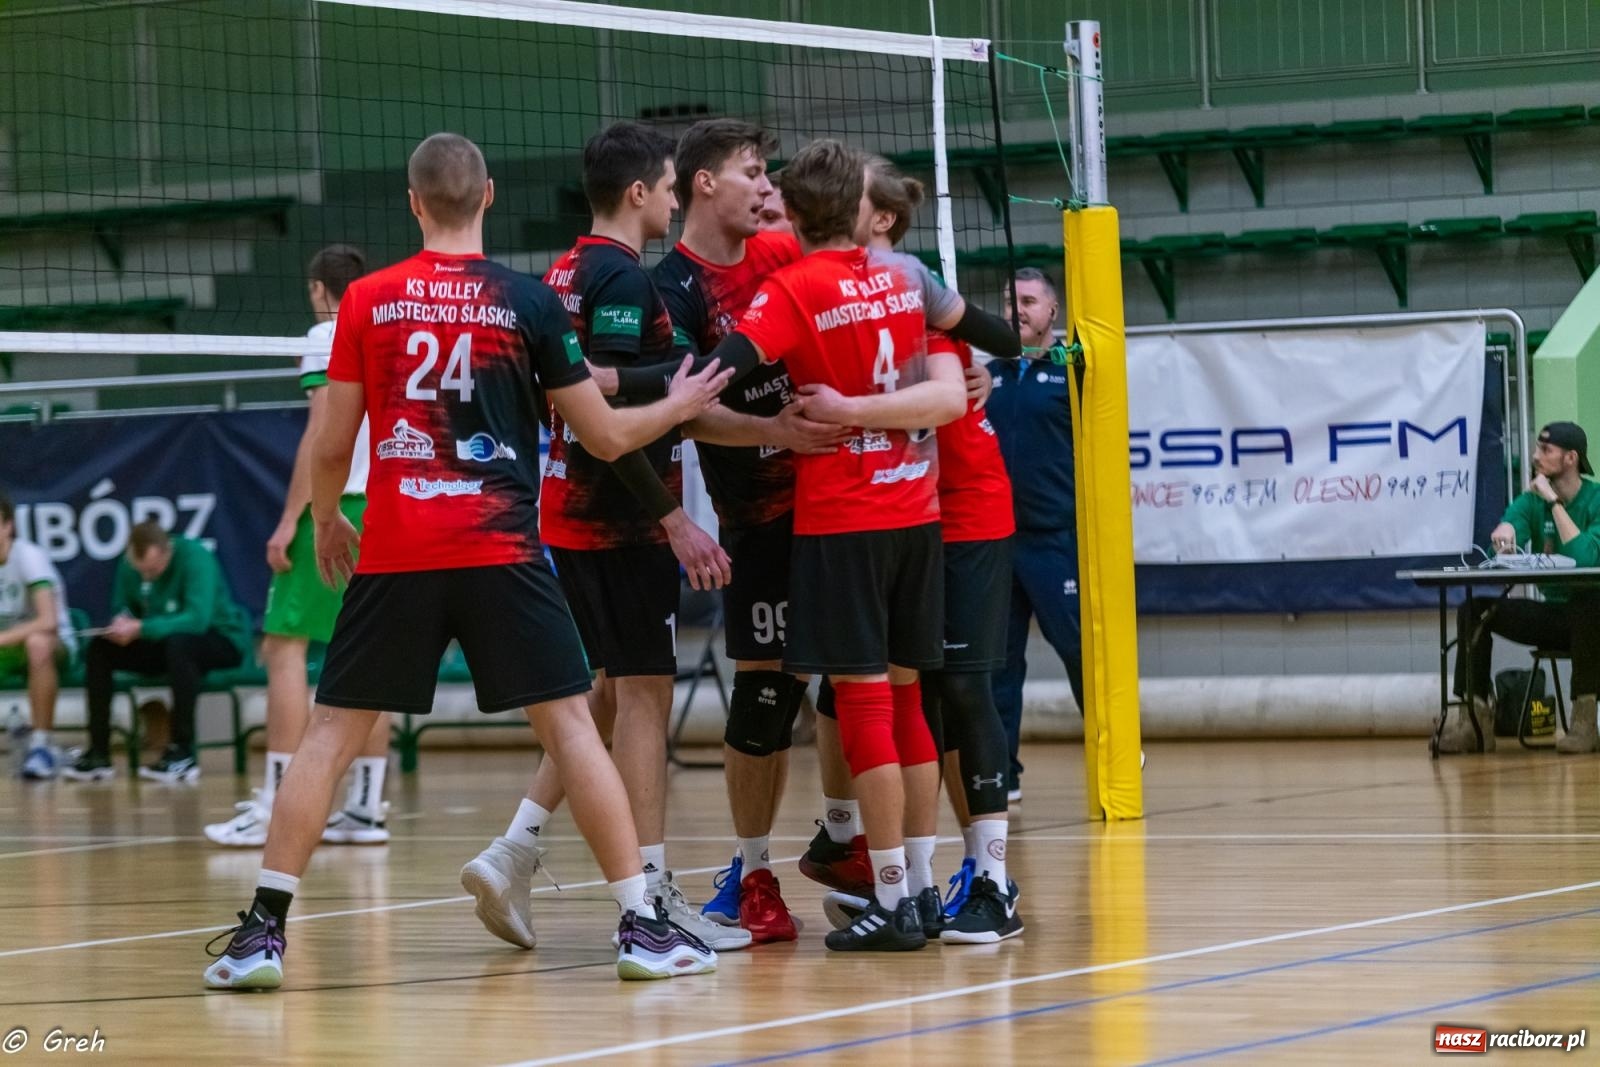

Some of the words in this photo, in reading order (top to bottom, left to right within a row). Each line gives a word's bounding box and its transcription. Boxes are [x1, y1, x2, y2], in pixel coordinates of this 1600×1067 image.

[406, 277, 425, 298] KS
[429, 281, 483, 300] VOLLEY
[838, 279, 857, 297] KS
[372, 300, 457, 326] MIASTECZKO
[460, 302, 517, 330] ŚLĄSKIE
[814, 301, 886, 332] MIASTECKO
[406, 331, 475, 403] 24
[873, 328, 900, 393] 4
[1328, 416, 1468, 463] FM
[1243, 478, 1277, 507] FM
[1294, 473, 1382, 504] OLESNO
[1434, 469, 1469, 498] FM
